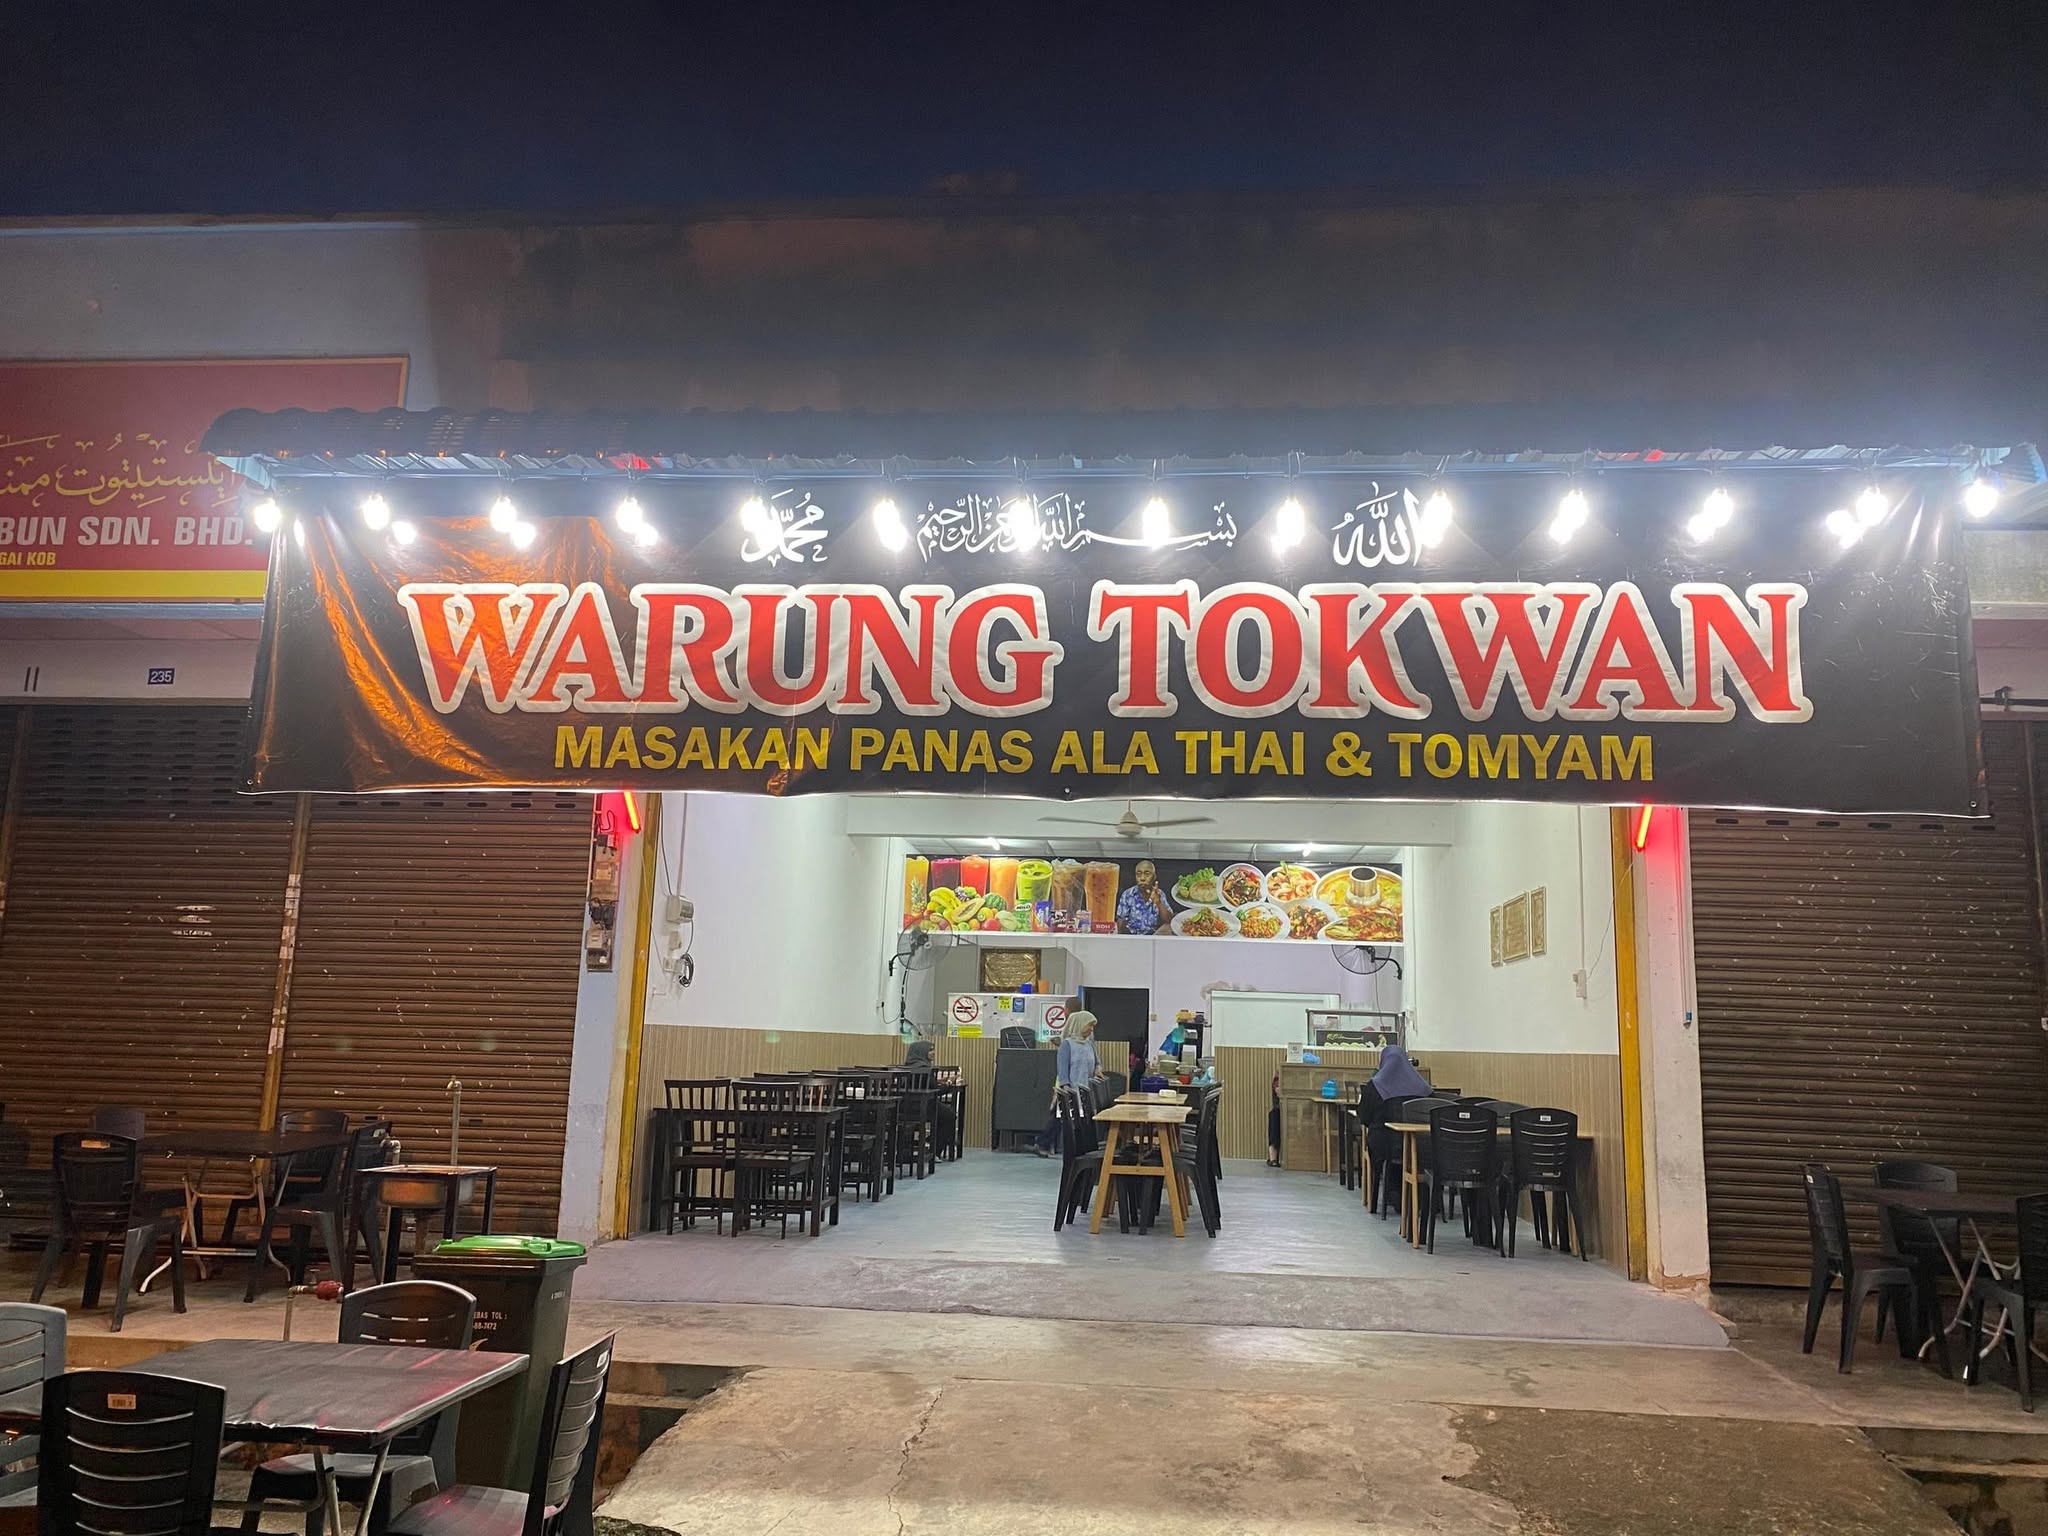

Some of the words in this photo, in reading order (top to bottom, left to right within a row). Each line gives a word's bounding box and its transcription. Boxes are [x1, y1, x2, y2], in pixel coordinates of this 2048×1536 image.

[78, 516, 160, 546] SDN.
[174, 516, 253, 546] BHD.
[27, 551, 56, 566] KOB
[397, 582, 1063, 717] WARUNG
[1087, 579, 1814, 722] TOKWAN
[150, 670, 173, 683] 235
[554, 725, 832, 772] MASAKAN
[849, 727, 1035, 774] PANAS
[1050, 729, 1160, 775] ALA
[1176, 730, 1306, 777] THAI
[1326, 730, 1373, 778] &
[1388, 731, 1654, 782] TOMYAM
